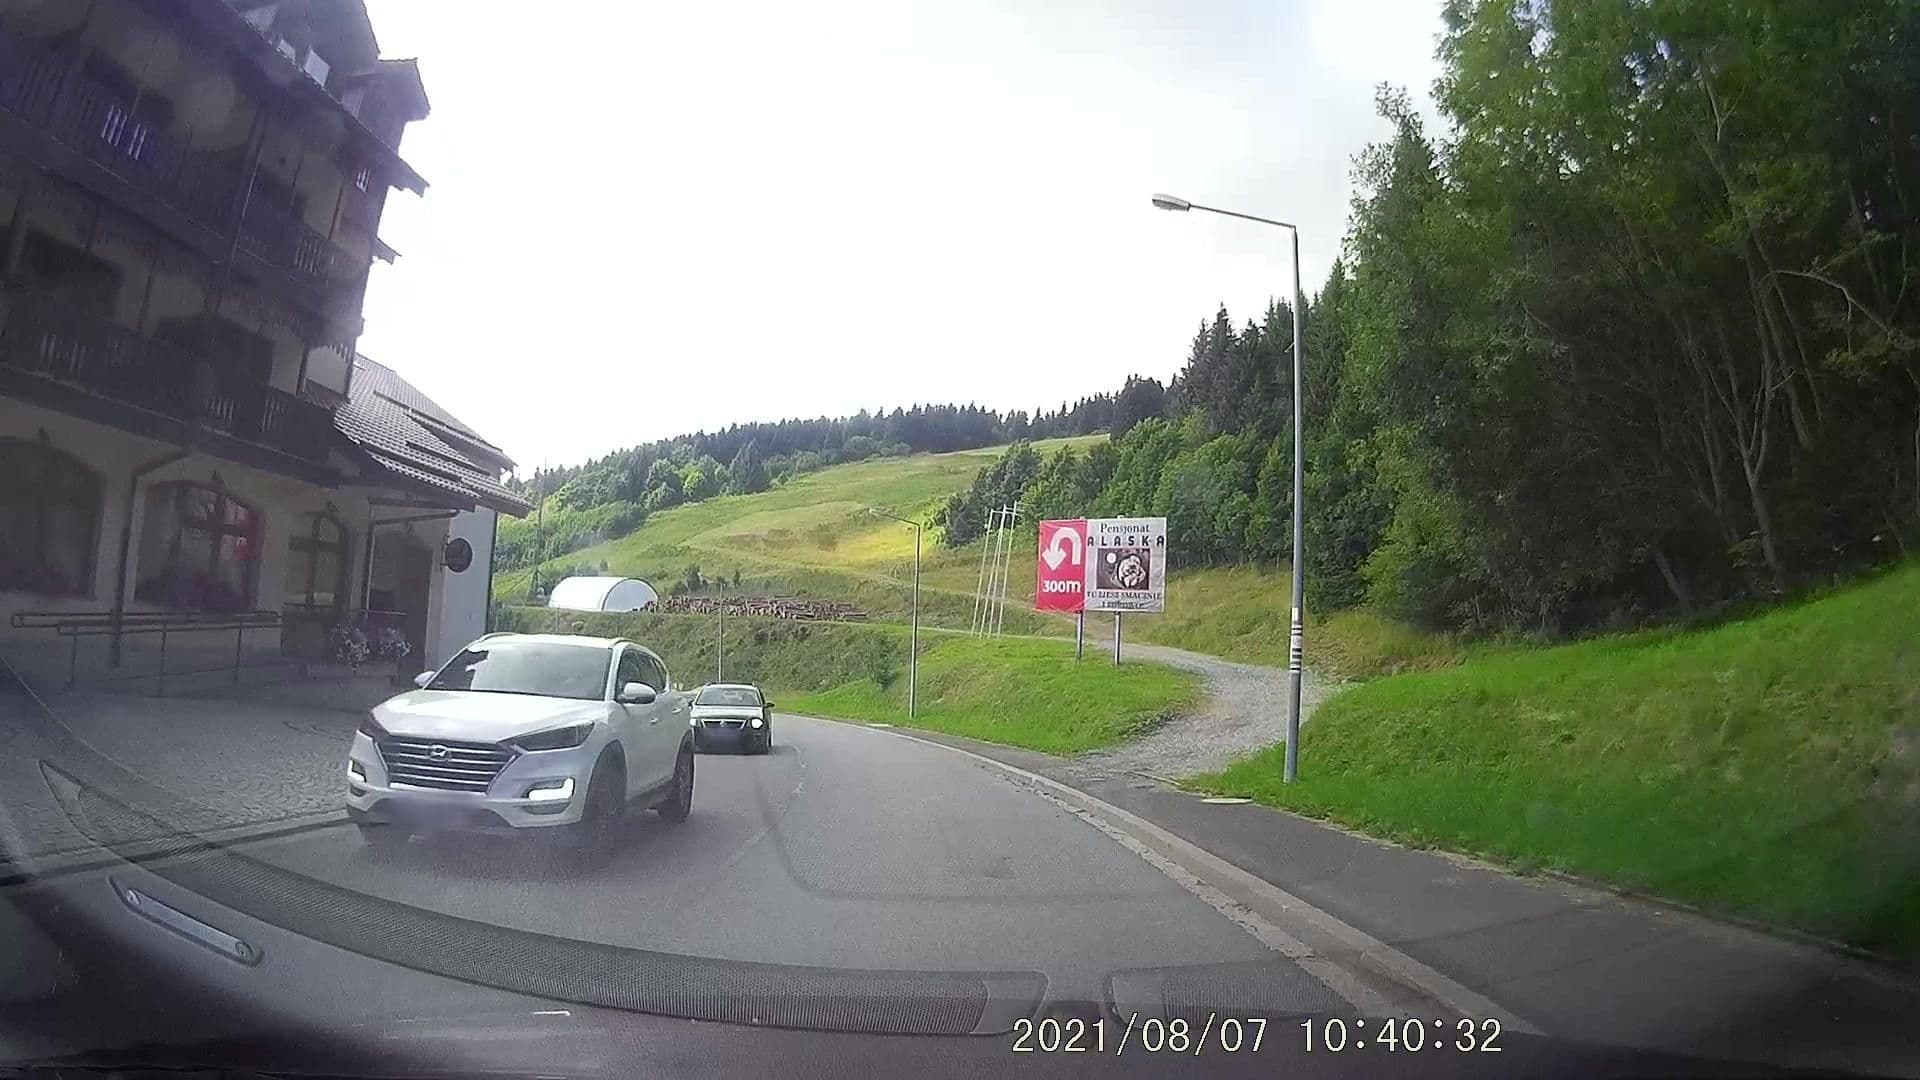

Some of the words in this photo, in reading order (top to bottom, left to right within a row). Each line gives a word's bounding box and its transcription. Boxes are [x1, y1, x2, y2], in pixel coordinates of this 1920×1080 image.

[1100, 523, 1150, 534] Pensjonat
[1087, 536, 1165, 546] ALASKA
[1043, 580, 1081, 593] 300m
